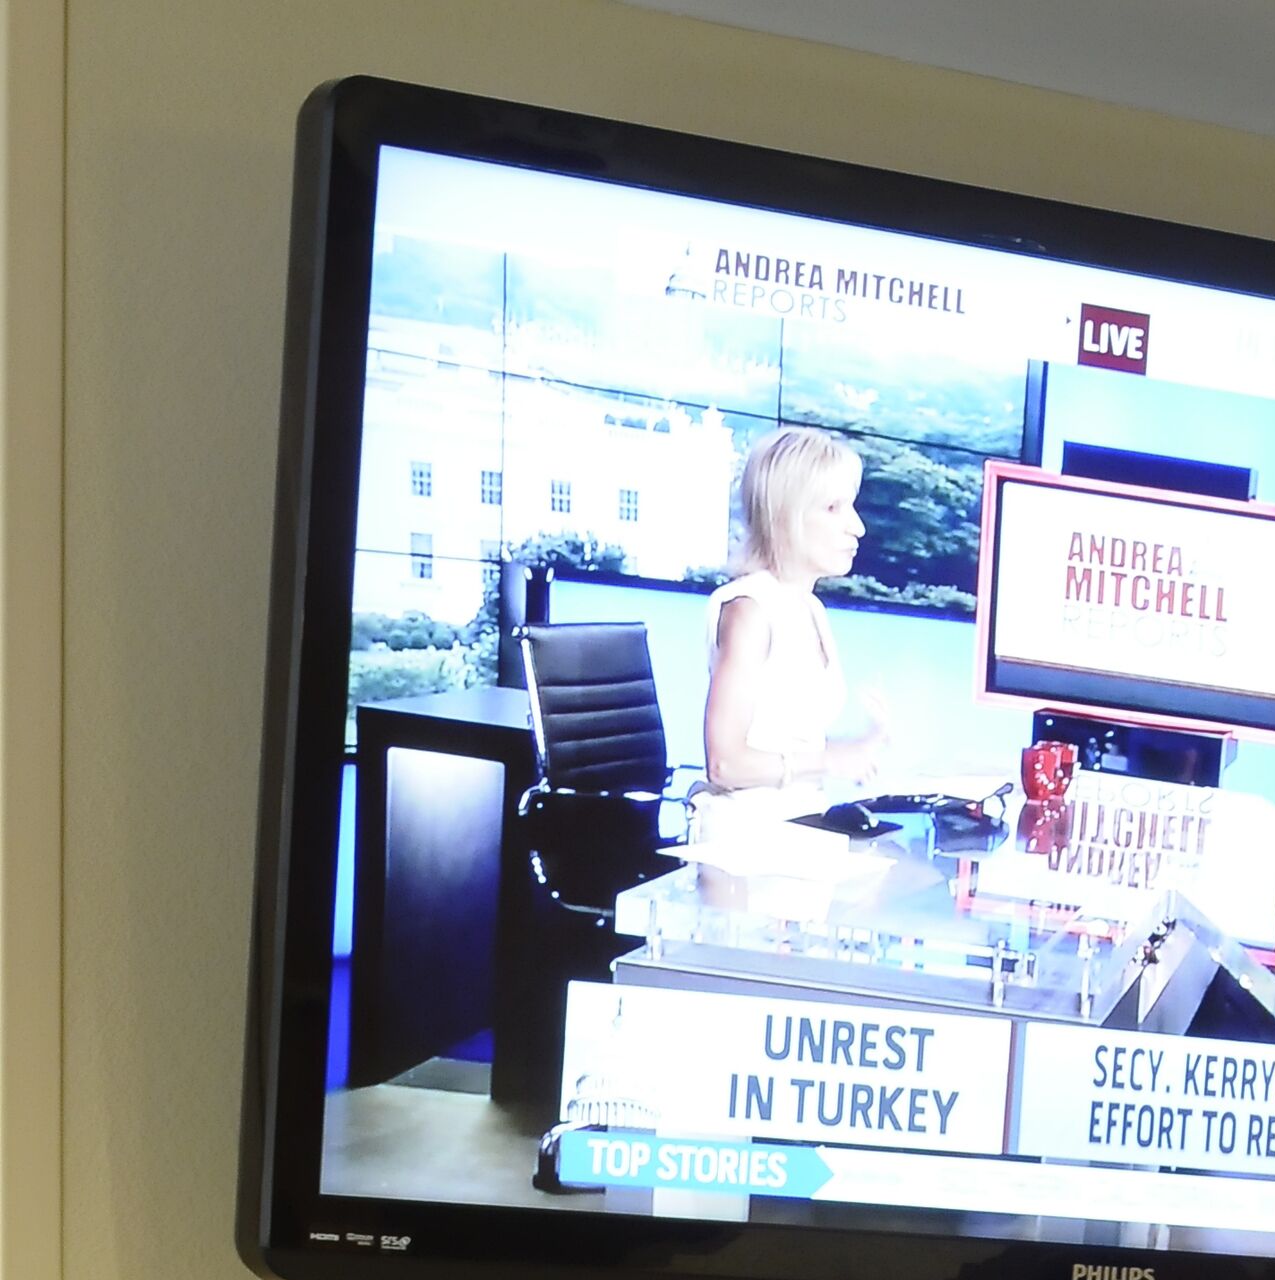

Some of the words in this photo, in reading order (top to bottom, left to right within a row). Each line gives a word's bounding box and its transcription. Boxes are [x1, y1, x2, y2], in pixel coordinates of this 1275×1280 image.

[711, 278, 848, 324] REPORTS
[714, 248, 825, 292] ANDREA
[835, 267, 966, 315] MITCHELL
[1083, 319, 1145, 362] LIVE
[1068, 530, 1184, 574] ANDREA
[1064, 565, 1229, 622] MITCHELL
[764, 1014, 934, 1073] UNREST
[1092, 1044, 1171, 1094] SECY.
[729, 1073, 773, 1120] IN
[789, 1079, 960, 1135] TURKEY
[1088, 1101, 1193, 1151] EFFORT
[1202, 1109, 1236, 1155] TO
[587, 1137, 649, 1178] TOP
[657, 1145, 788, 1186] STORIES
